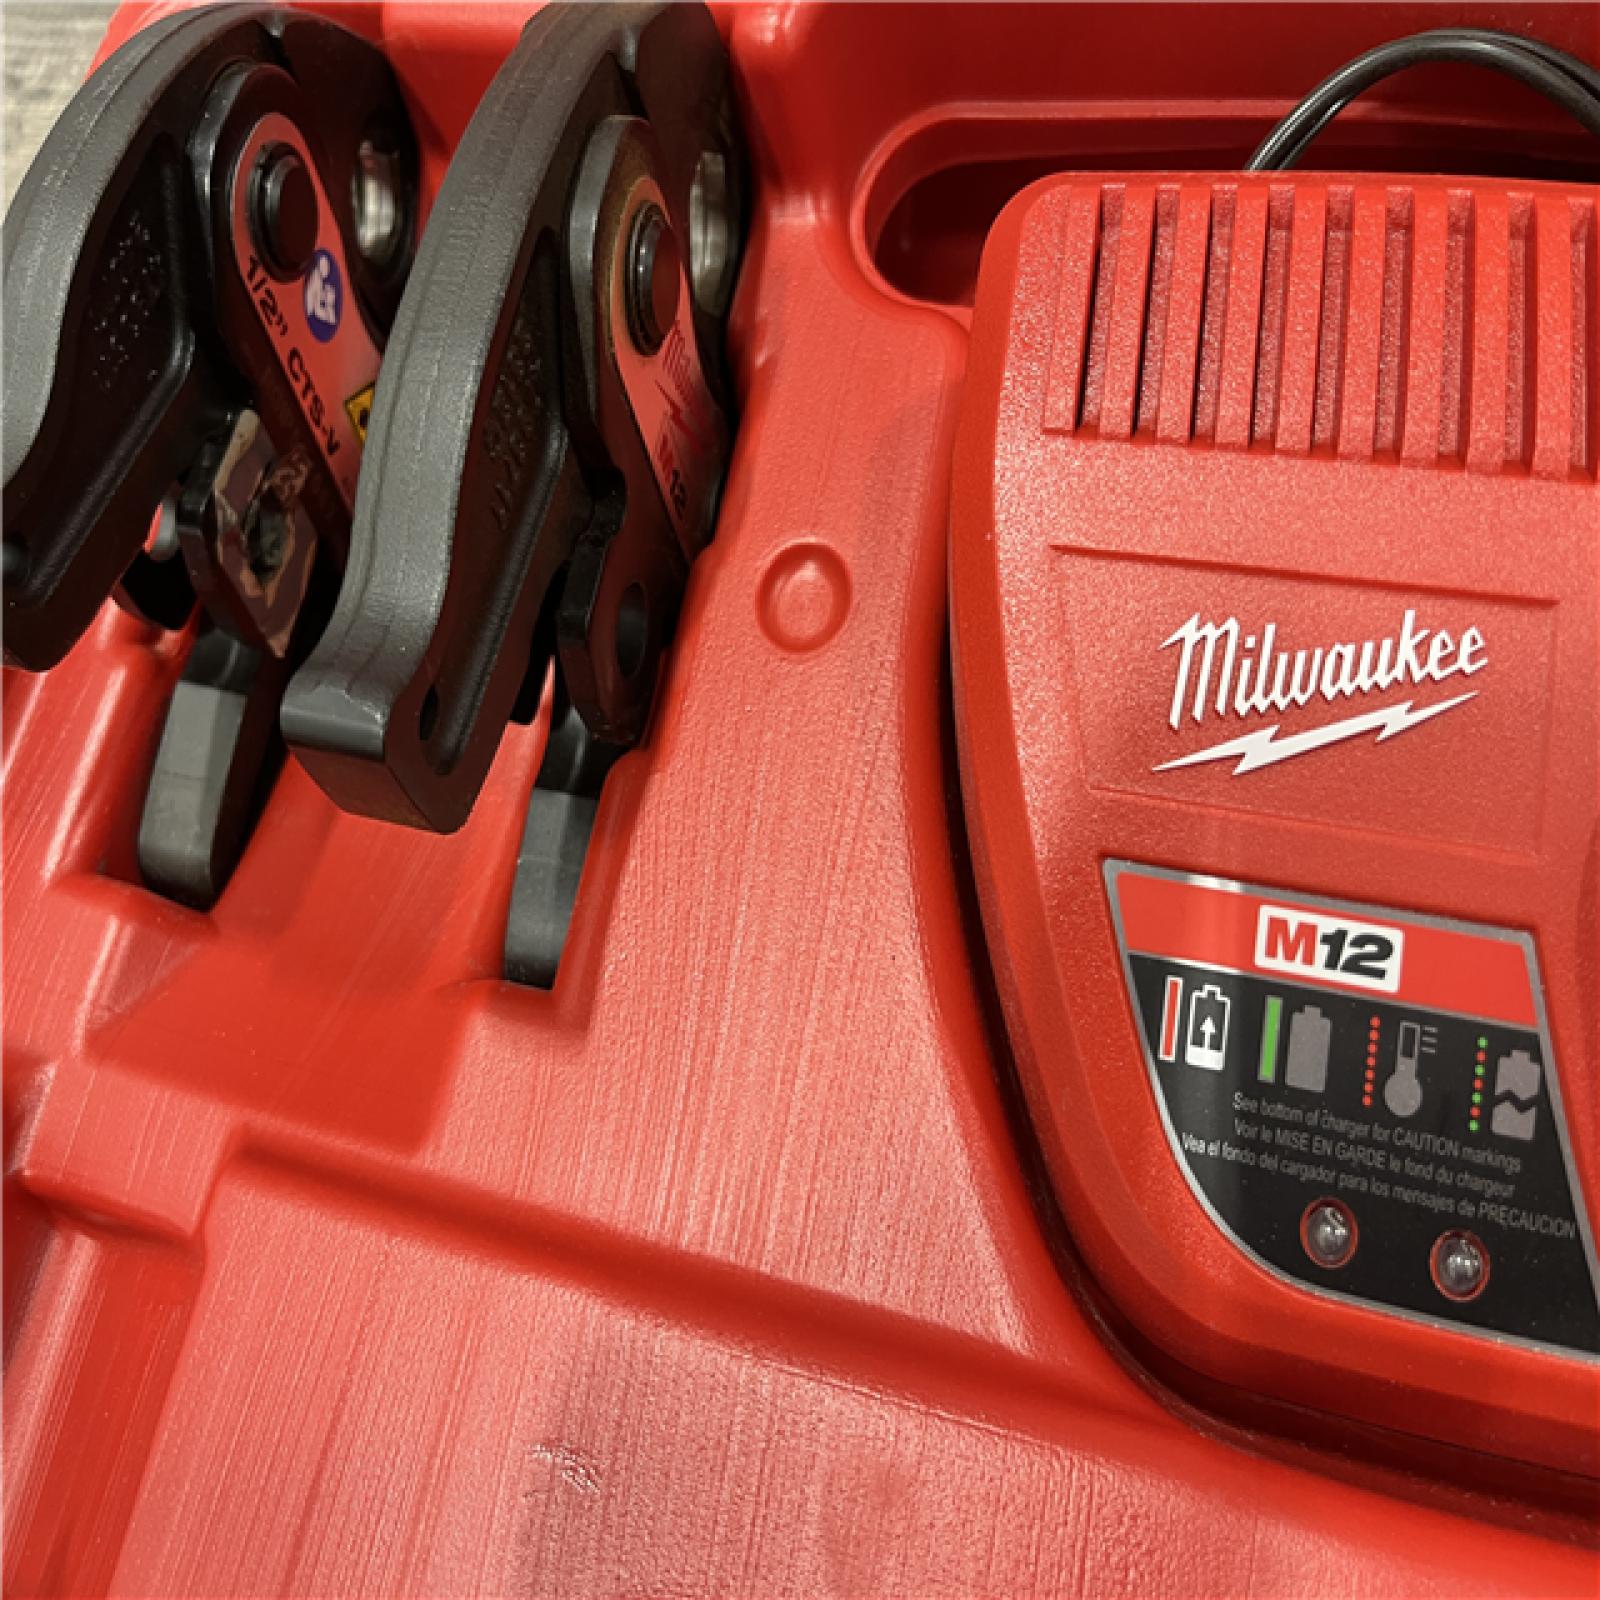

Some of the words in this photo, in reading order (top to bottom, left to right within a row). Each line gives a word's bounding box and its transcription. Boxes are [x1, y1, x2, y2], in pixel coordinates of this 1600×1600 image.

[1158, 609, 1488, 730] Milwaukee
[1264, 915, 1394, 980] M12
[1232, 1091, 1258, 1113] See
[1260, 1097, 1303, 1121] bottom
[1304, 1108, 1320, 1126] of
[1320, 1110, 1370, 1138] charger
[1372, 1122, 1391, 1141] for
[1392, 1126, 1461, 1157] CAUTION
[1461, 1146, 1521, 1175] markings
[1234, 1117, 1258, 1138] Voir
[1275, 1127, 1310, 1151] MISE
[1312, 1134, 1333, 1156] EN
[1334, 1141, 1386, 1168] GARDE
[1404, 1157, 1433, 1181] fond
[1435, 1165, 1452, 1184] du
[1454, 1170, 1516, 1198] chargeur
[1181, 1131, 1206, 1154] Vea
[1207, 1138, 1220, 1156] el
[1221, 1140, 1255, 1166] fondo
[1259, 1150, 1278, 1170] del
[1279, 1158, 1336, 1183] cargador
[1337, 1171, 1368, 1191] para
[1369, 1175, 1391, 1197] los
[1392, 1186, 1456, 1214] mensajes
[1456, 1198, 1476, 1218] de
[1477, 1200, 1576, 1240] PRECAUCION
